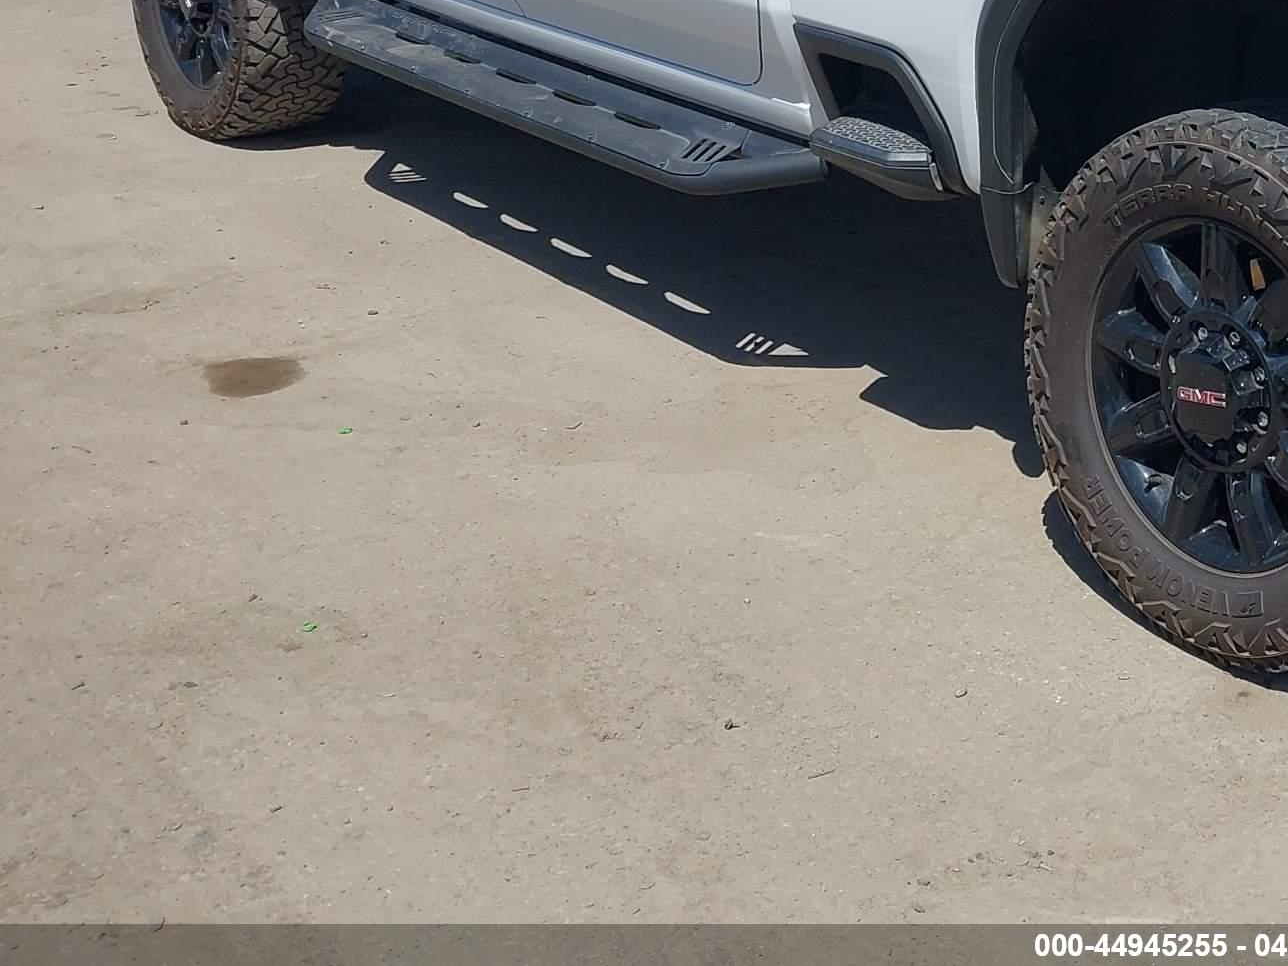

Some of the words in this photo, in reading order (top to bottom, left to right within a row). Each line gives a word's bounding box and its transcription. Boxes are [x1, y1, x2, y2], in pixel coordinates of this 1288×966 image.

[1104, 183, 1192, 227] TERRA
[1178, 386, 1226, 408] GMC
[1082, 474, 1151, 570] POWER
